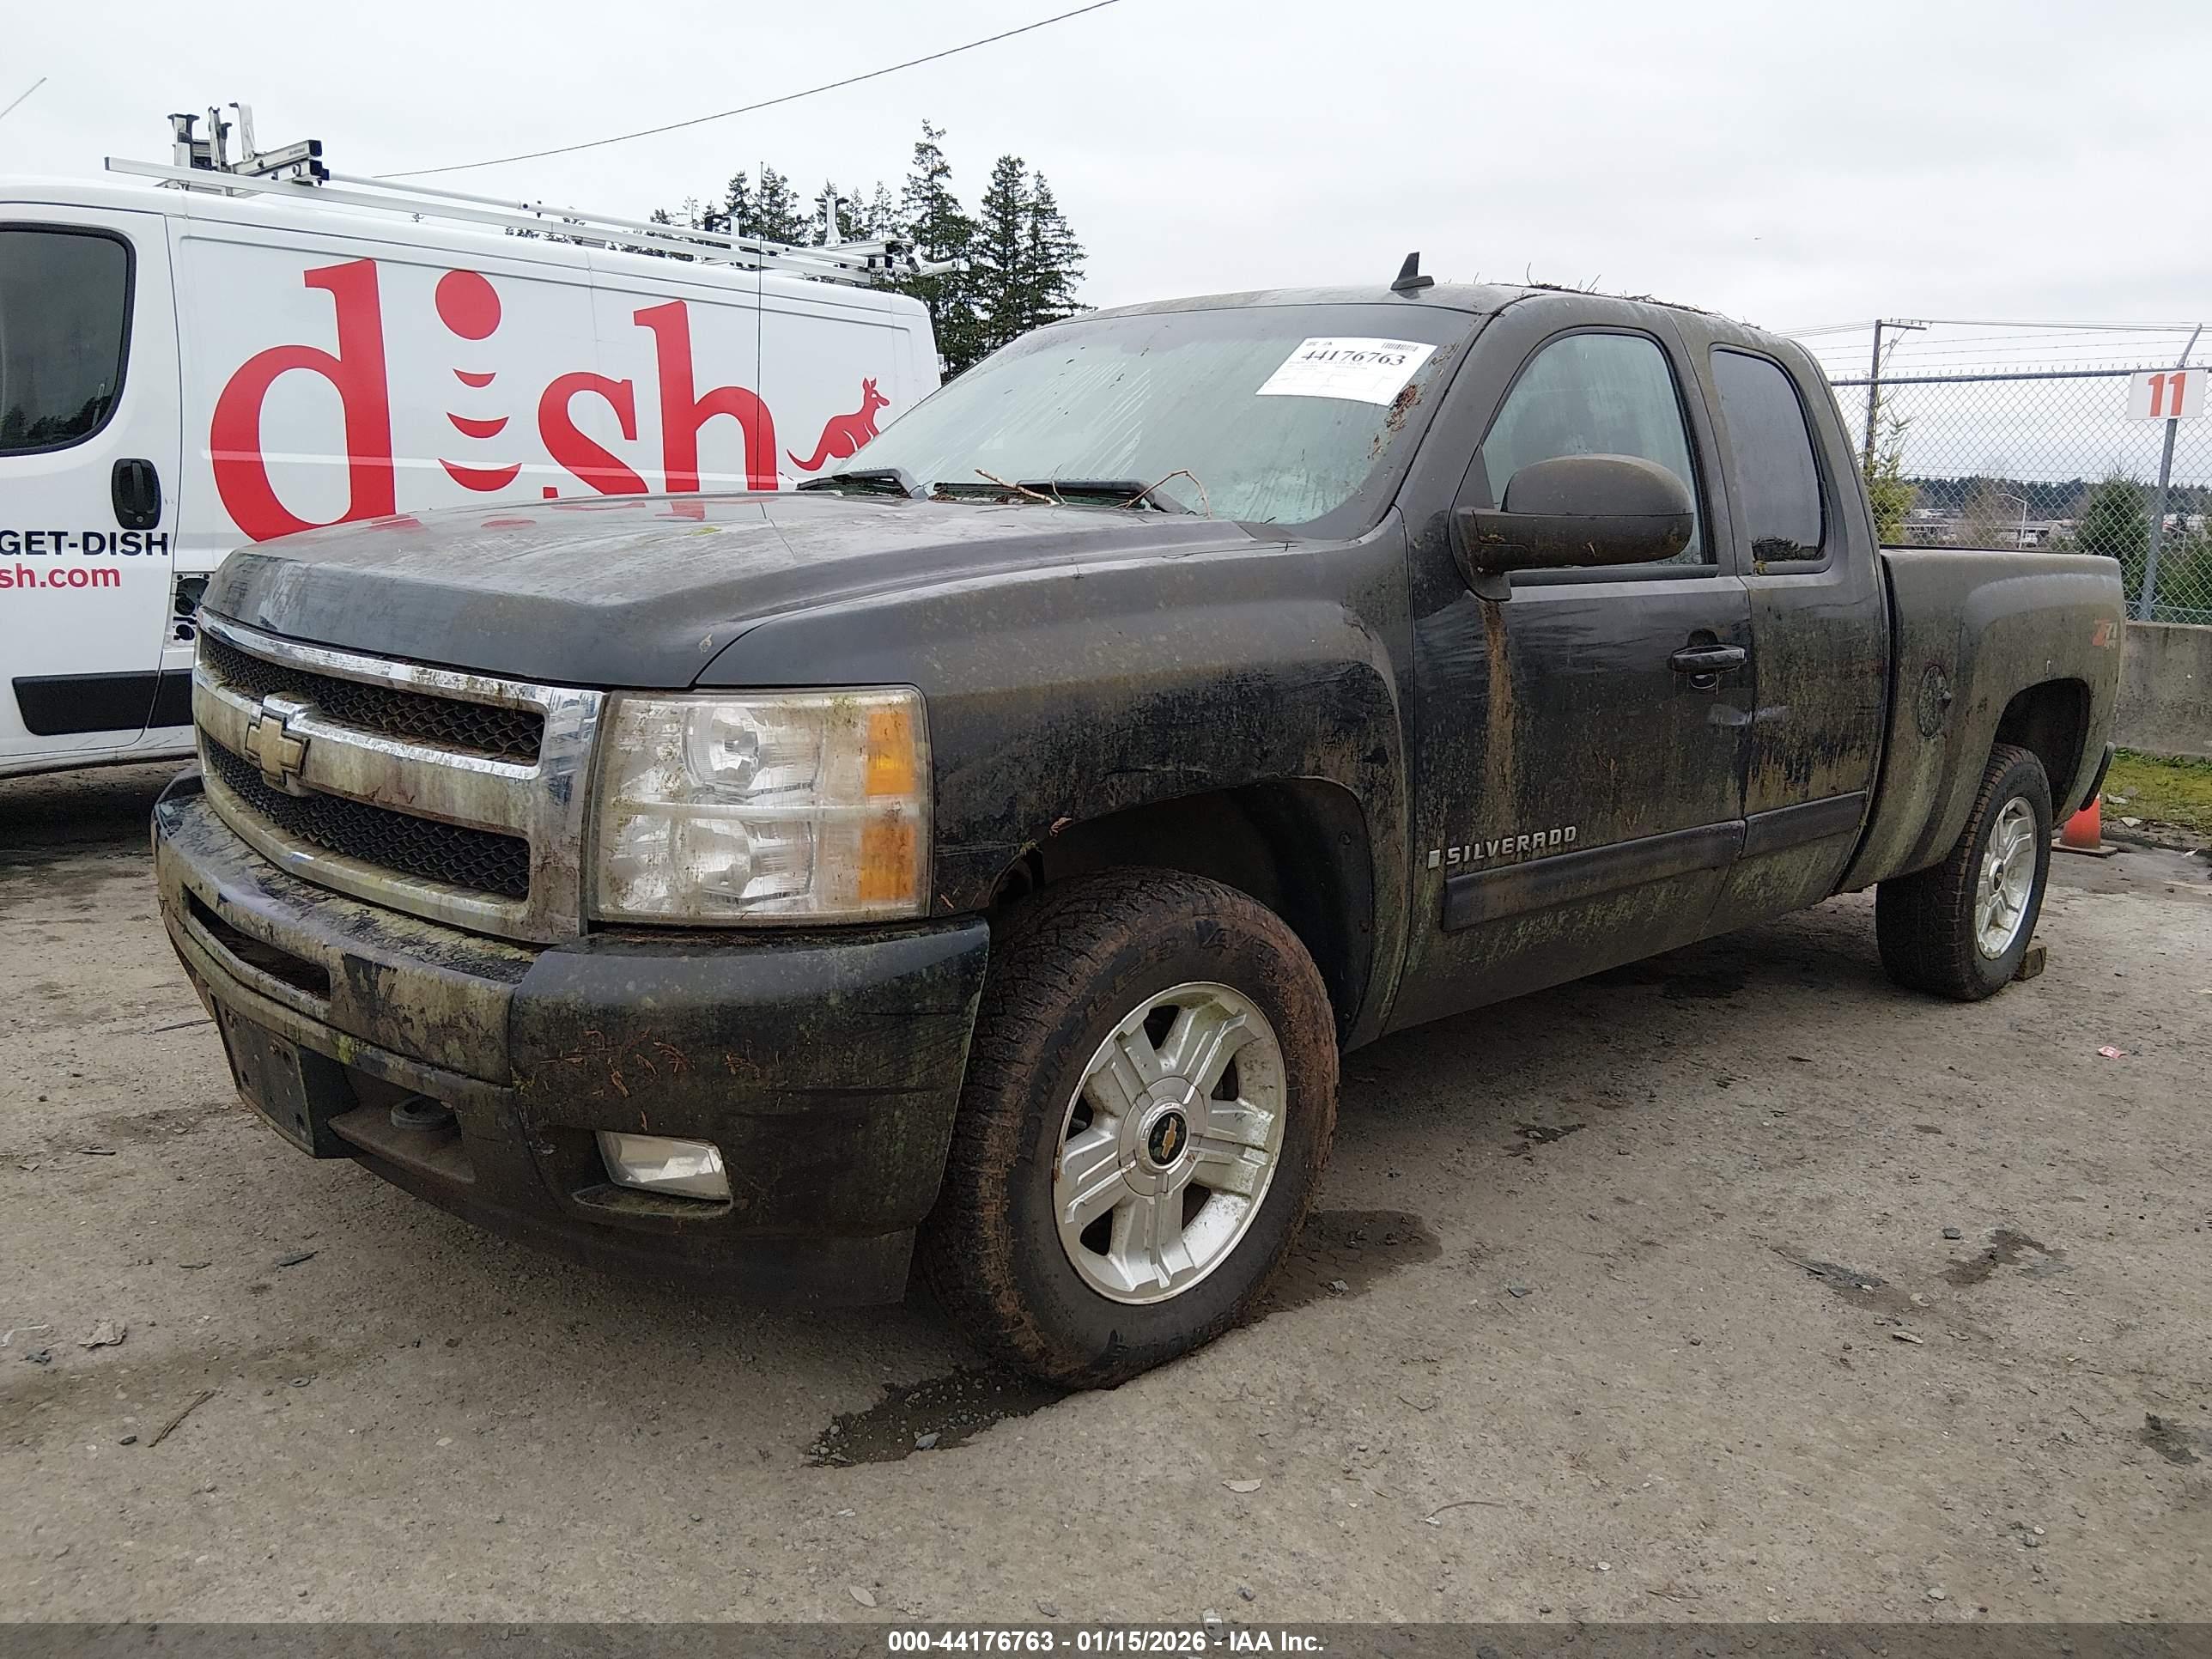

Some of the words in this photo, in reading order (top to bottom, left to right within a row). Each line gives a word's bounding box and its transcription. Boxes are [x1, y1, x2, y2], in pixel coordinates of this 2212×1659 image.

[1301, 349, 1407, 366] 44176763
[210, 258, 779, 543] dish
[2148, 372, 2186, 416] 11
[0, 530, 168, 556] GET-DISH
[1446, 826, 1577, 866] SILVERADO
